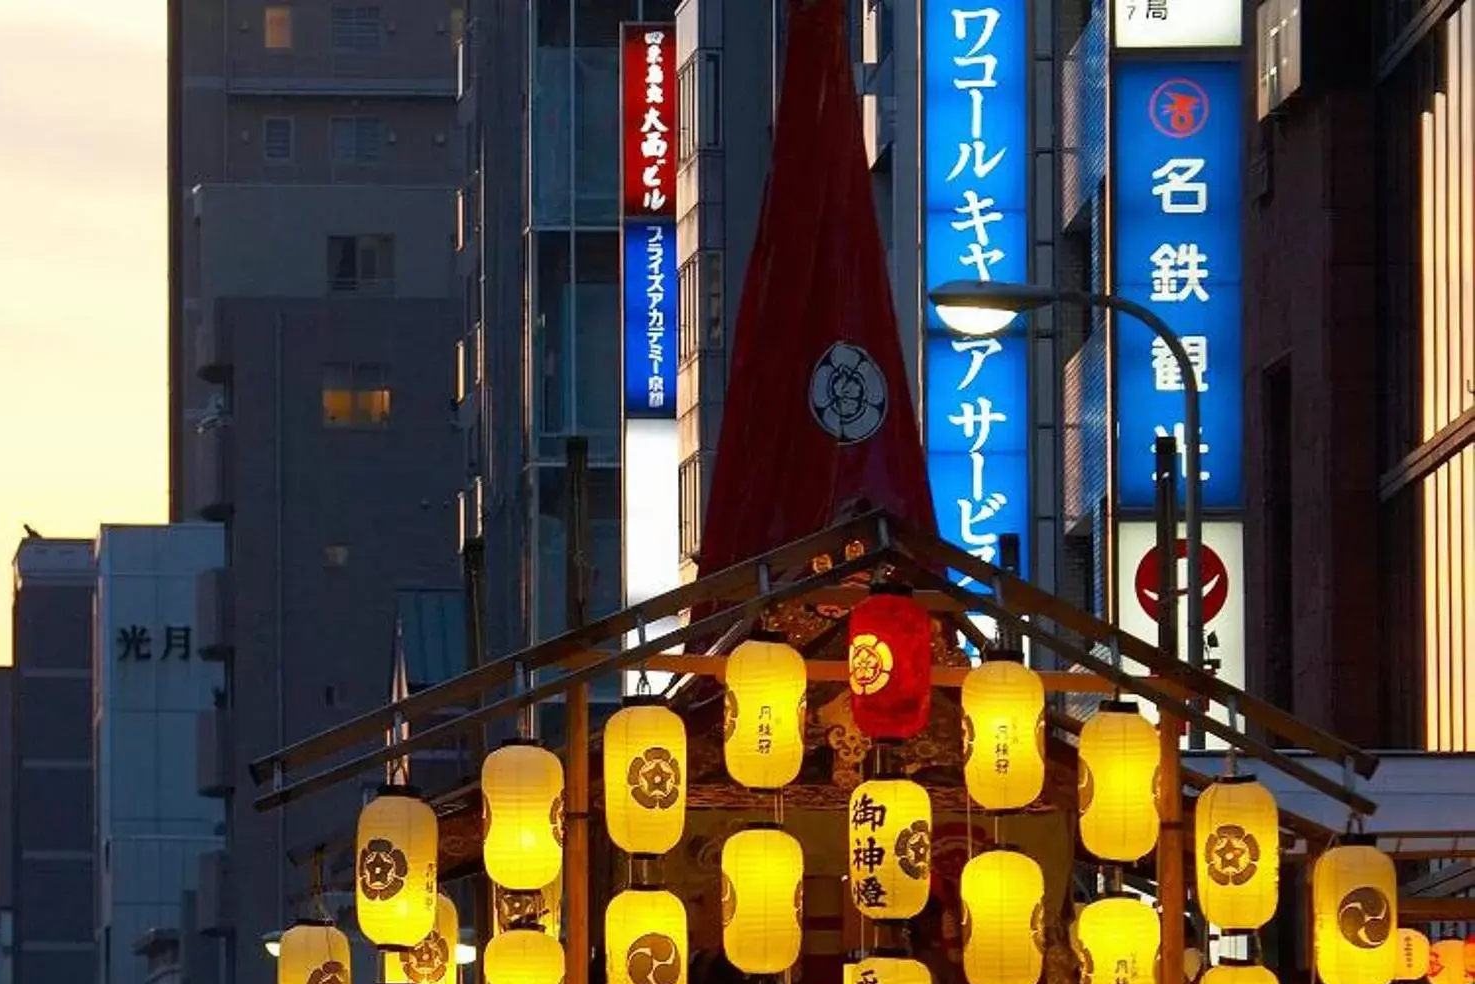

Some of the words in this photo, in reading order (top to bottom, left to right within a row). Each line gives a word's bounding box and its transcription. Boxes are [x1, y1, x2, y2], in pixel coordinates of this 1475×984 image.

[947, 8, 1007, 587] ワコールキャアサービ
[116, 626, 192, 662] 光月
